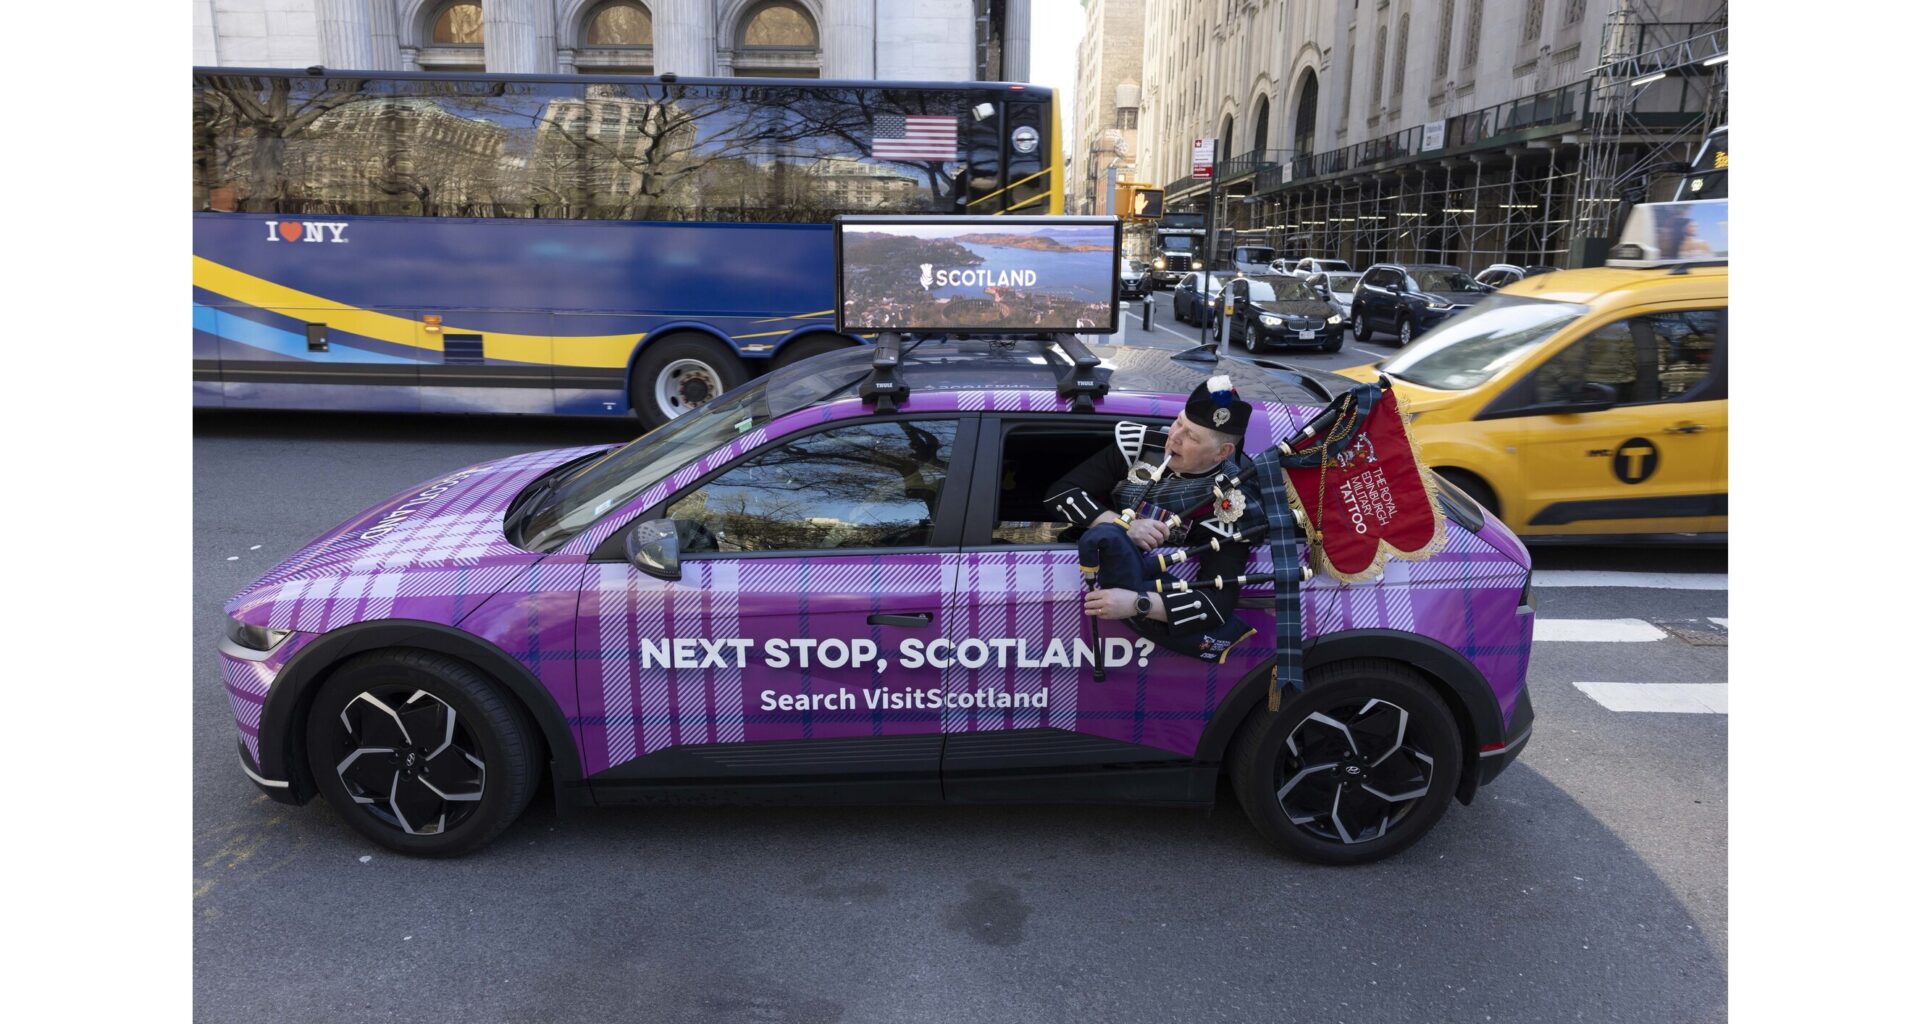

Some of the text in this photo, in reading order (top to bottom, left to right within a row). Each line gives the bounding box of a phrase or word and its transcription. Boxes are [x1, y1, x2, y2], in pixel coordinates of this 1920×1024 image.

[936, 269, 1037, 287] SCOTLAND
[1339, 480, 1367, 534] TATTOO
[1351, 475, 1374, 516] MILITARY
[1361, 470, 1390, 526] EDINBURGH
[1373, 467, 1398, 518] THE ROYAL
[641, 637, 1155, 674] NEXT STOP, SCOTLAND?
[760, 687, 1049, 711] Search VisitScotland
